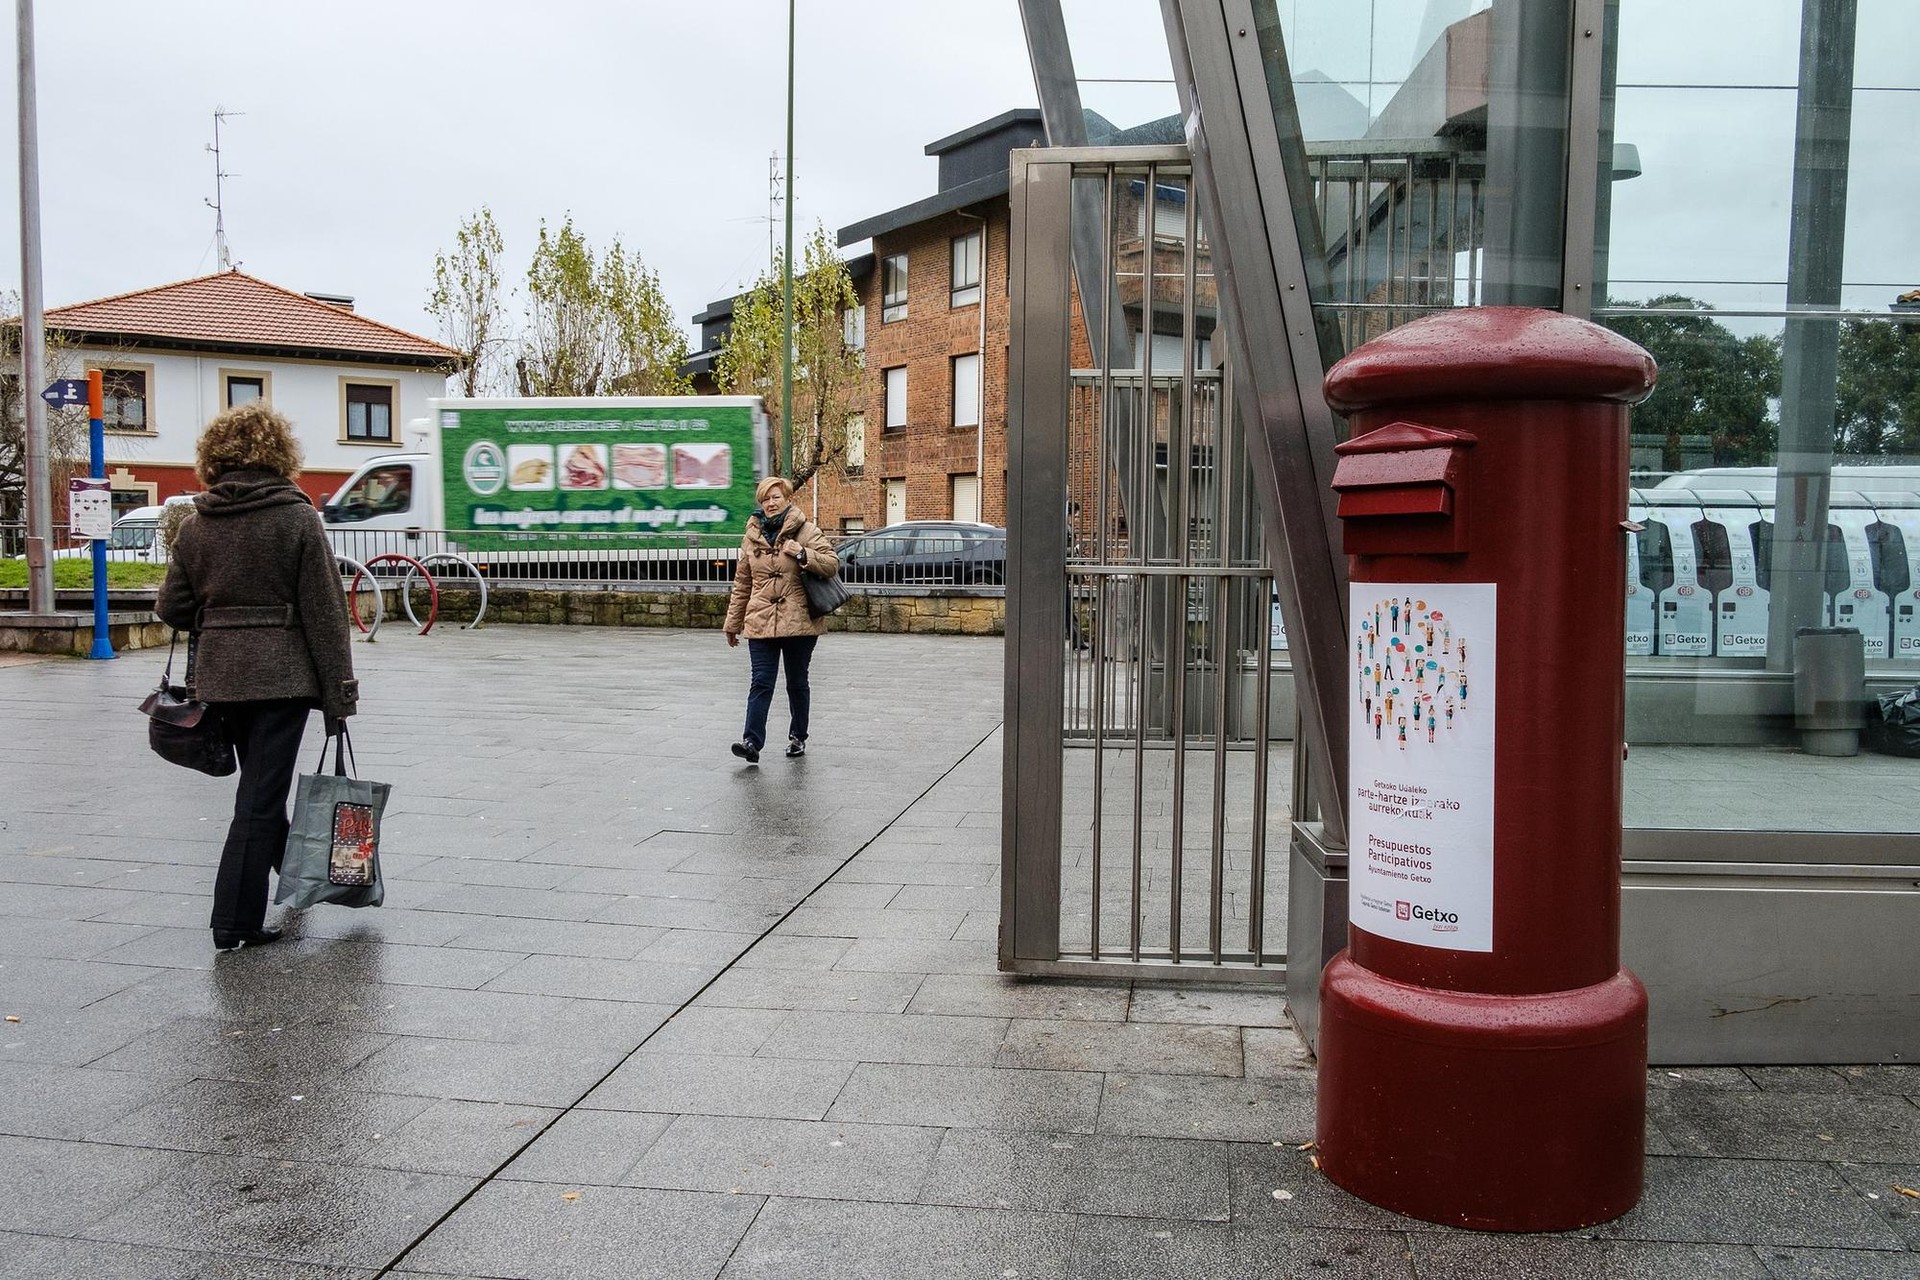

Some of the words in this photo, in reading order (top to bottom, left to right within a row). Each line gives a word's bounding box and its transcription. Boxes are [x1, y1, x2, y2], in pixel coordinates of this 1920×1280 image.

[1627, 635, 1649, 643] etxo
[1677, 635, 1707, 644] Getxo
[1735, 636, 1765, 645] Getxo
[1863, 639, 1883, 648] etxo
[1368, 834, 1432, 856] Presupuestos
[1368, 848, 1432, 871] Participativos
[1368, 864, 1409, 881] Ayuntamiento
[1410, 873, 1432, 884] Getxo
[1412, 904, 1459, 924] Getxo
